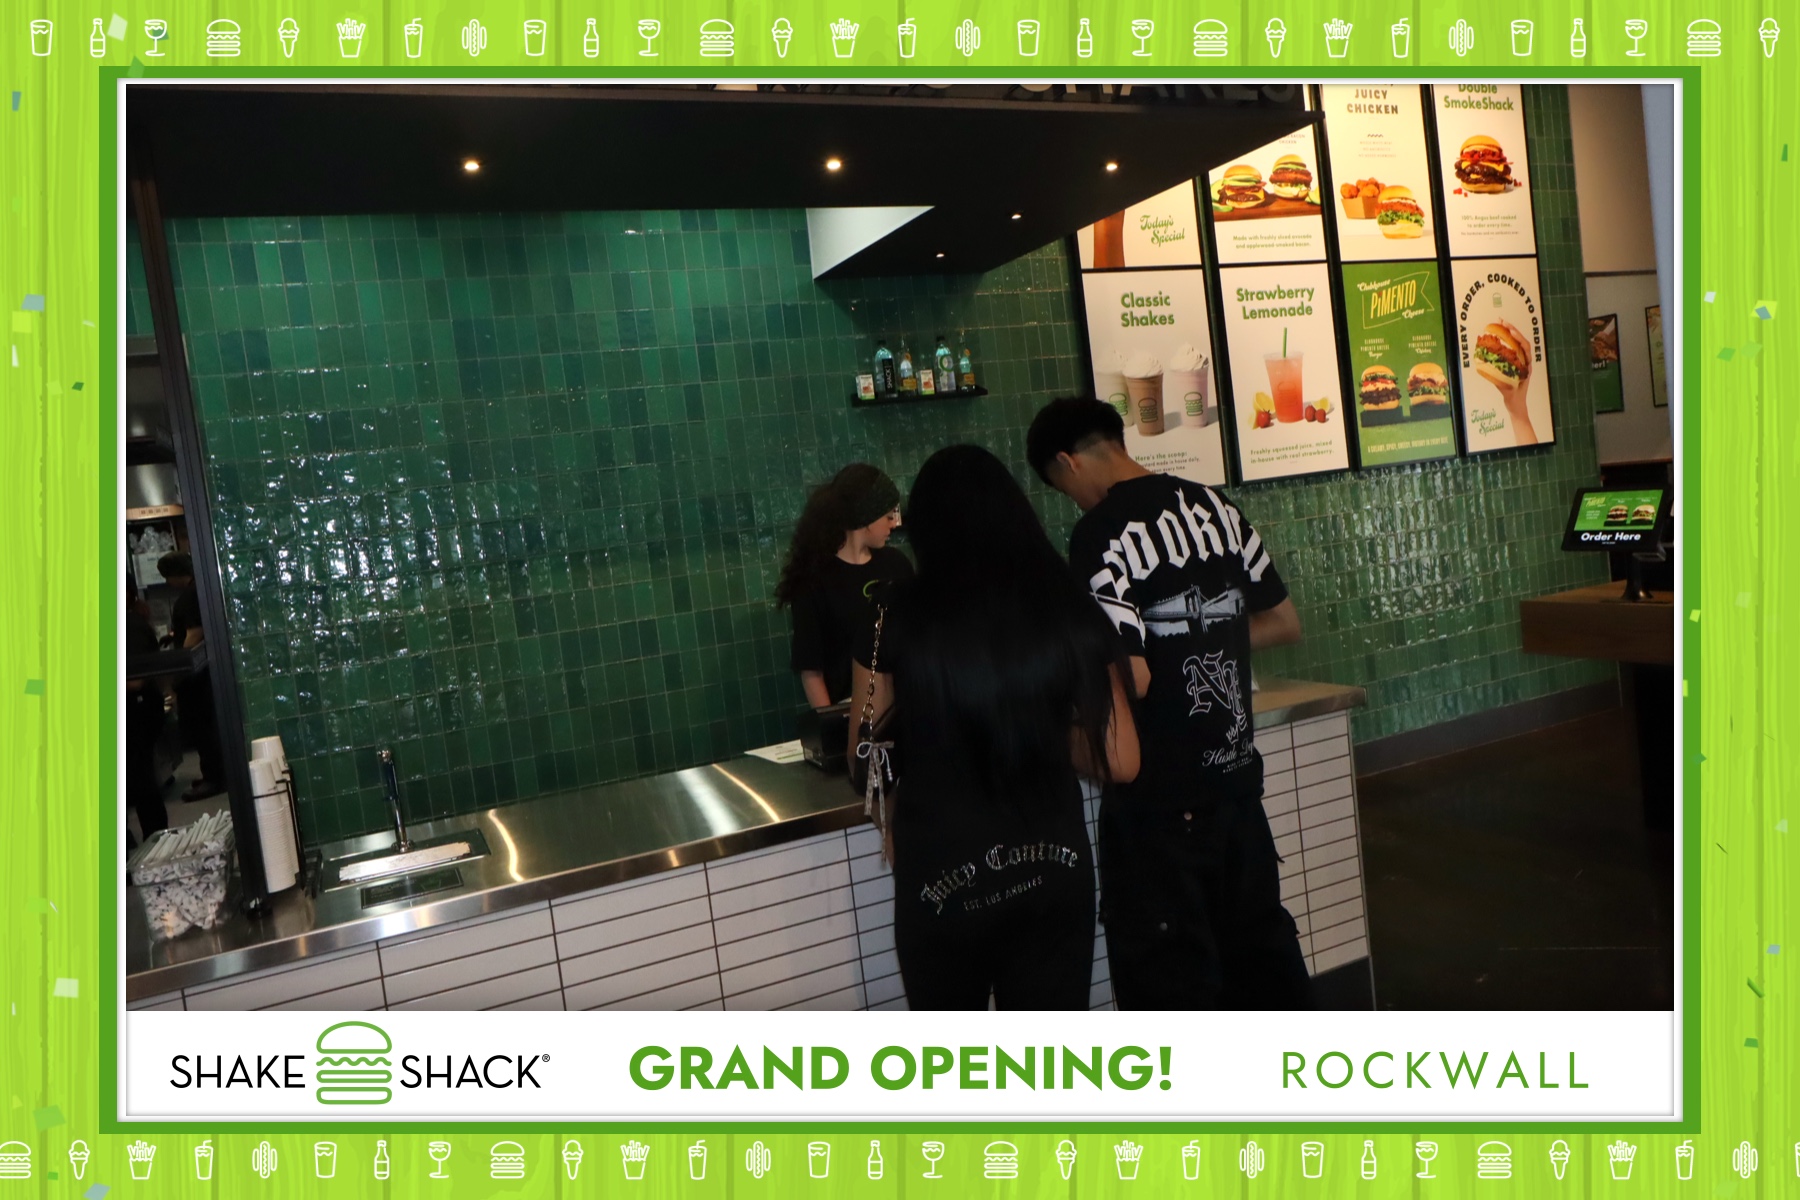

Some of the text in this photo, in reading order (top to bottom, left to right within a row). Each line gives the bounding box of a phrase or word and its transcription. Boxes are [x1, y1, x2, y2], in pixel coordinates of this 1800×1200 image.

[1355, 88, 1388, 100] JUICY
[1444, 95, 1514, 111] SmokeShack
[1347, 103, 1399, 115] CHICKEN
[1140, 214, 1175, 234] Today's
[1151, 228, 1185, 247] Special
[1236, 284, 1315, 302] Strawberry
[1357, 279, 1391, 292] Clubhouse
[1121, 290, 1171, 308] Classic
[1121, 310, 1175, 327] Shakes
[1242, 301, 1313, 320] Lemonade
[1460, 273, 1542, 369] EVERY ORDER, COOKED TO ORDER
[1470, 408, 1497, 425] Today's
[1479, 419, 1505, 438] Special
[1135, 454, 1155, 462] Here's
[1250, 447, 1271, 456] Freshly
[1272, 444, 1299, 454] squeezed
[1581, 531, 1642, 541] Order Here
[1202, 744, 1238, 767] Hustle
[920, 840, 1078, 916] Juicy Couture
[963, 875, 1043, 912] EST. LOS ANGELES
